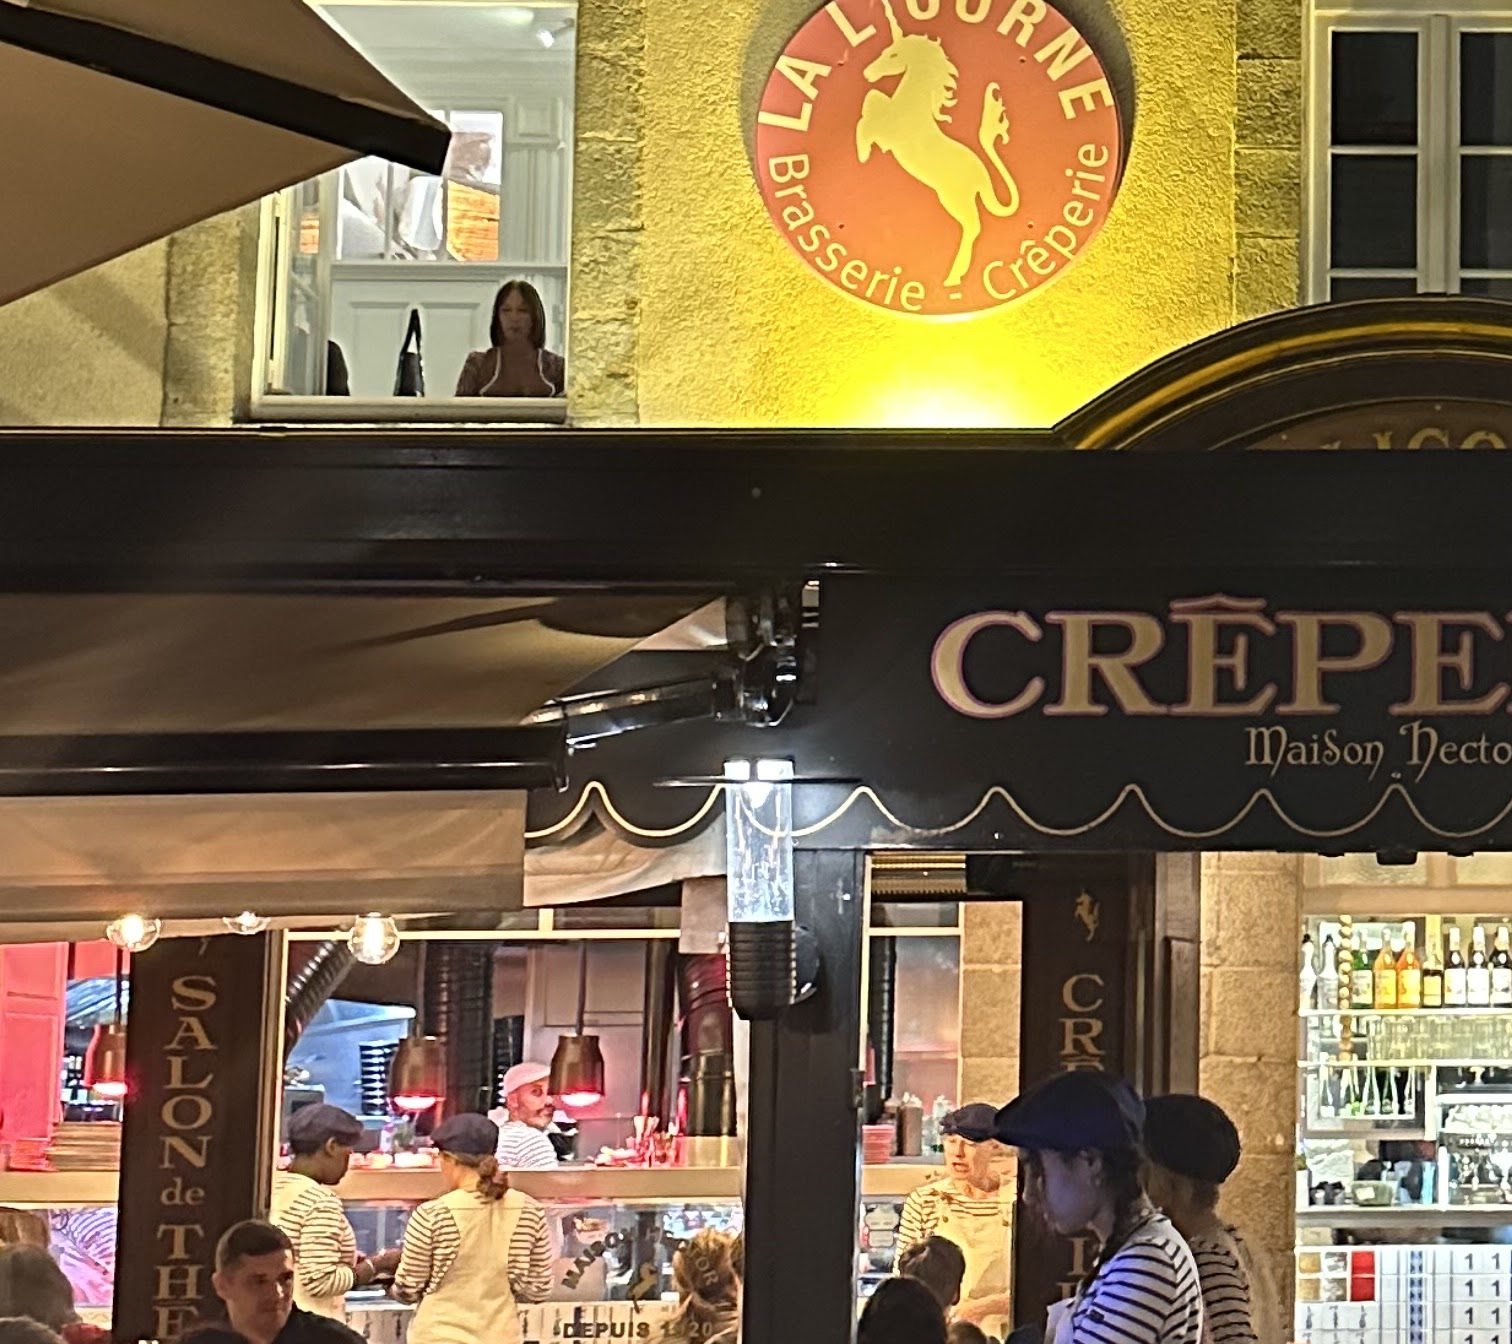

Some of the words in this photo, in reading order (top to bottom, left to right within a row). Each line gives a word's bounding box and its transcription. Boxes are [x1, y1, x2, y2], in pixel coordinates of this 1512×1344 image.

[758, 54, 832, 132] LA
[769, 153, 926, 312] Brasserie
[982, 143, 1109, 302] Crêperie
[1245, 725, 1384, 782] Maison
[158, 975, 219, 1169] SALON
[160, 1177, 205, 1205] de
[563, 1322, 650, 1339] DEPUIS
[660, 1320, 713, 1338] 120
